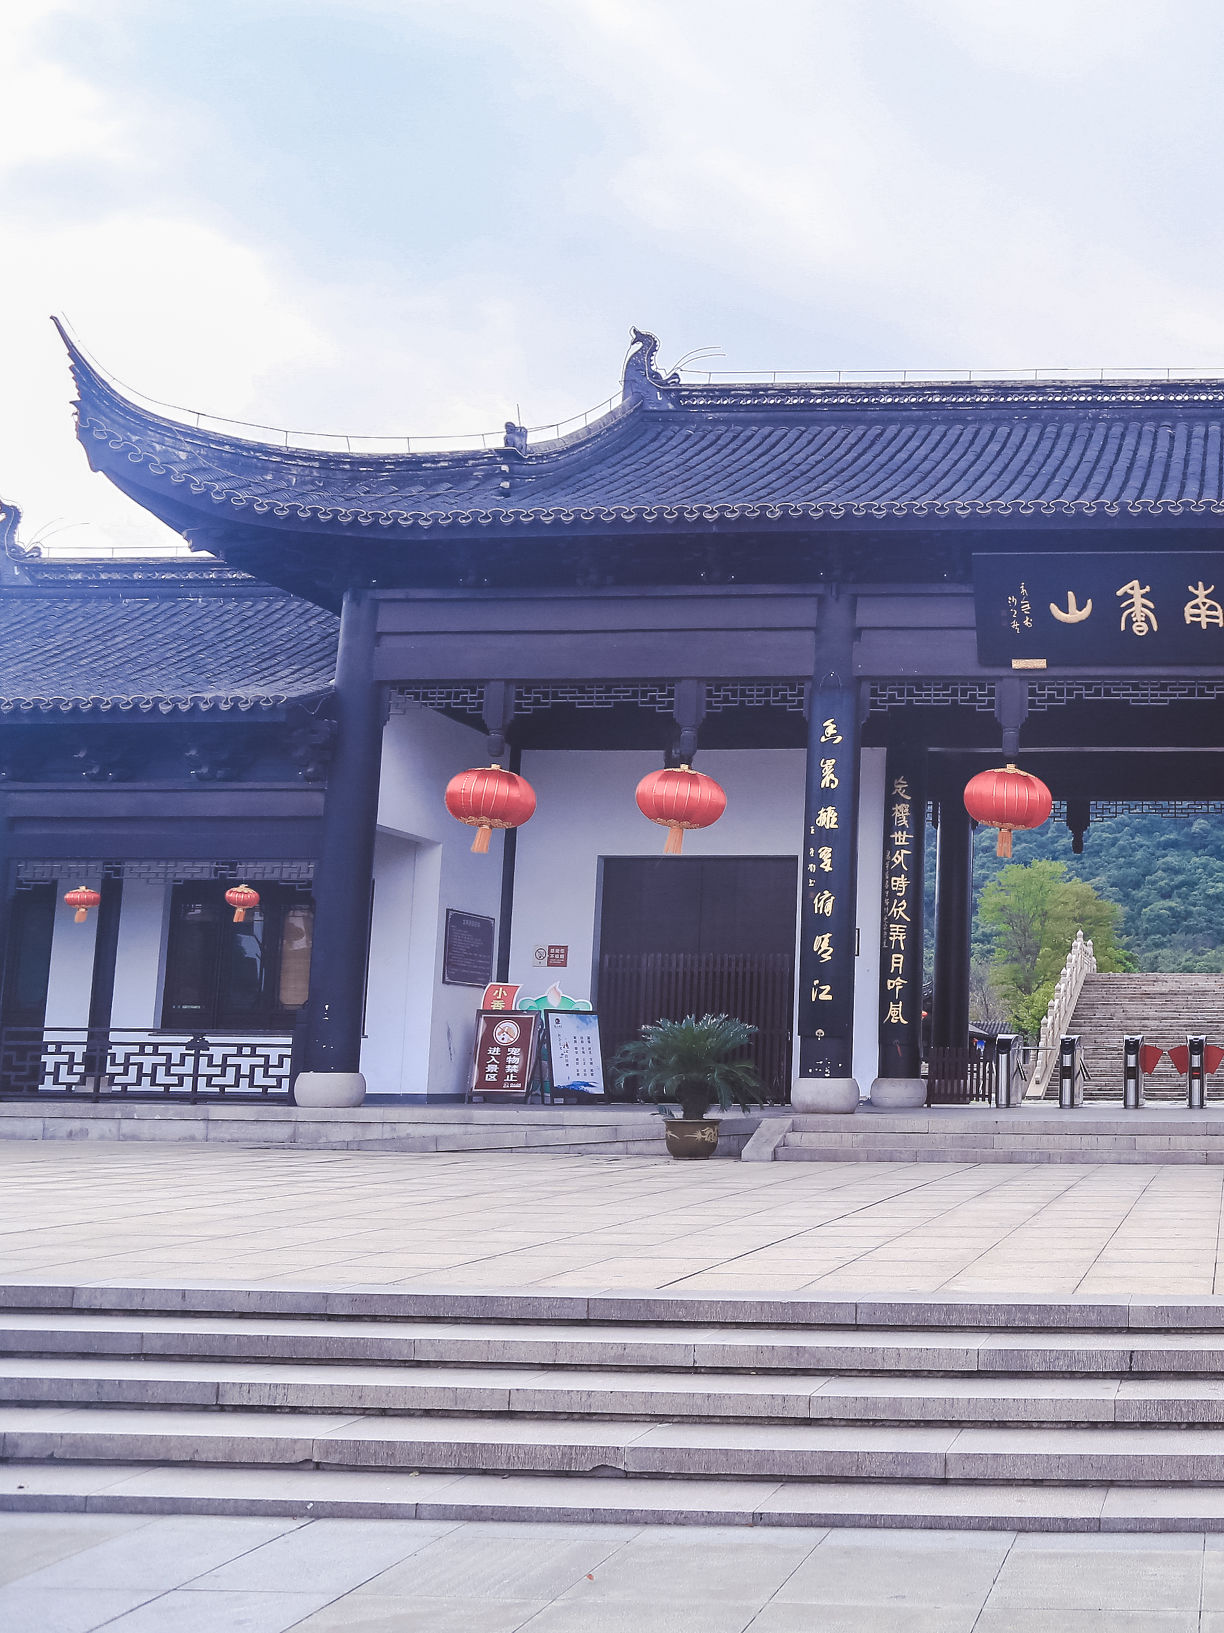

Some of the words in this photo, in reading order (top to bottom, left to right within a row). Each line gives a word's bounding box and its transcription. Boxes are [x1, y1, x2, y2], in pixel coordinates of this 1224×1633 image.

[485, 1047, 501, 1081] 进入景区
[504, 1047, 521, 1082] 宠物禁止
